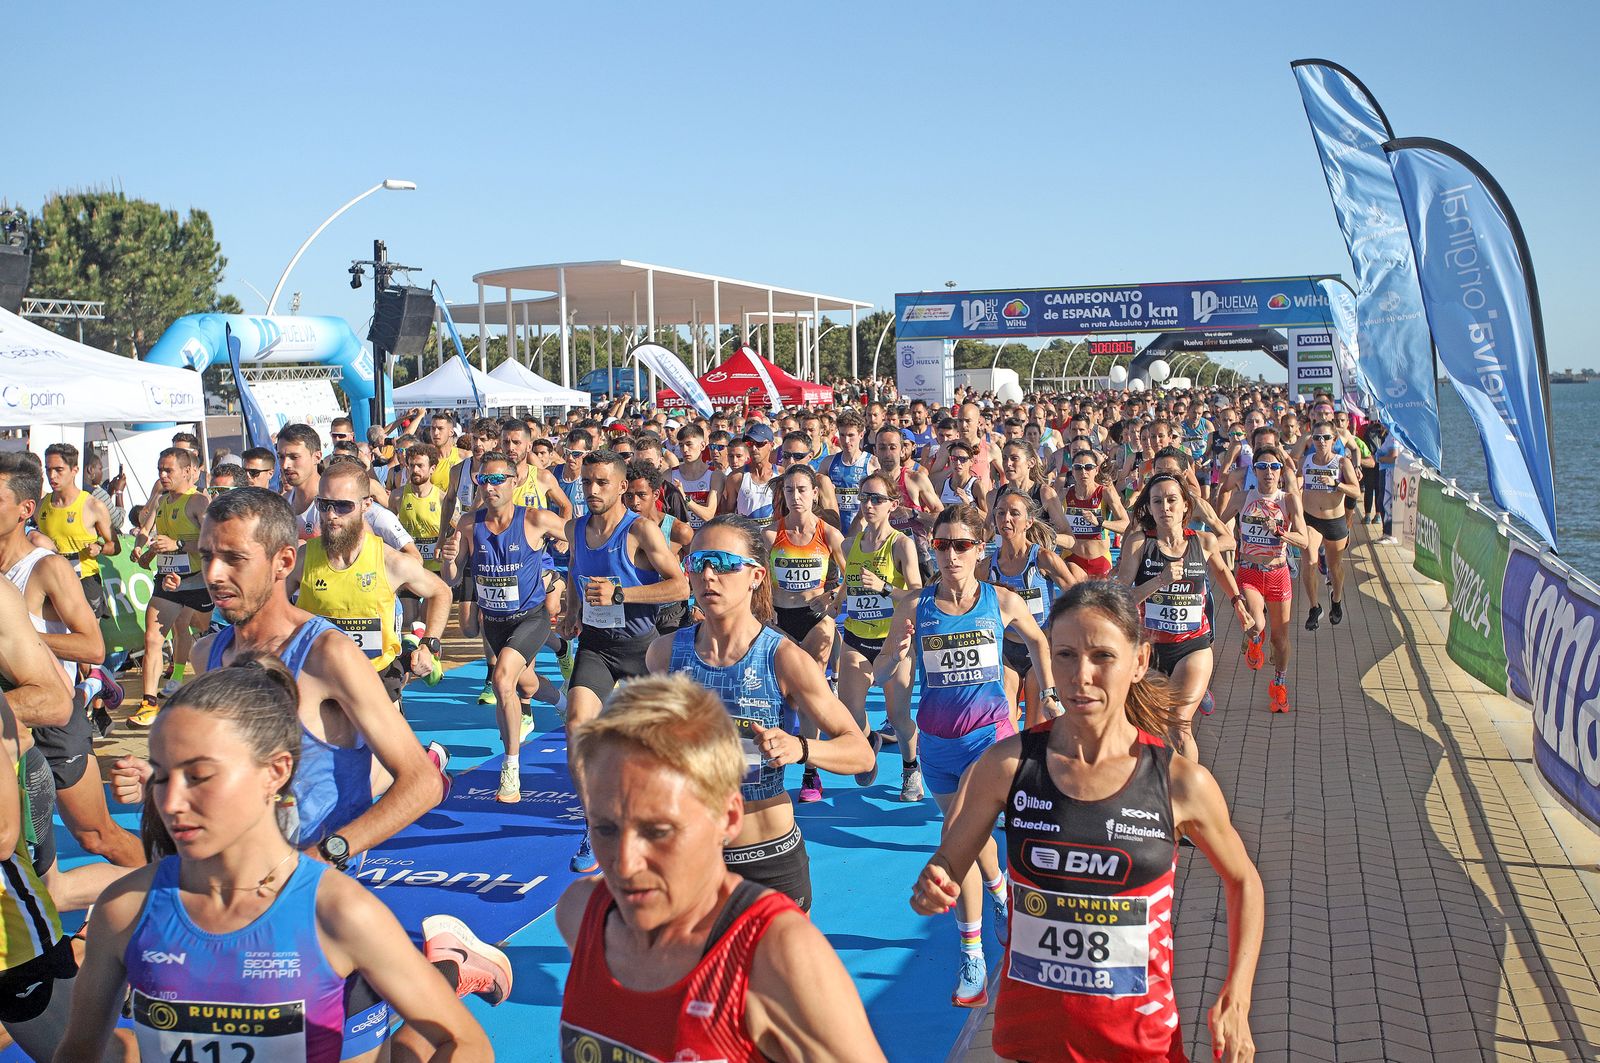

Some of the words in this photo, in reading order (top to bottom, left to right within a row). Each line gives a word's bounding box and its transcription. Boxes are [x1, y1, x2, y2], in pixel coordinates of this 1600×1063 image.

[1044, 290, 1142, 305] CAMPEONATO
[1216, 295, 1258, 309] HUELVA
[1044, 310, 1059, 320] de
[1062, 306, 1112, 319] ESPAÑA
[1120, 304, 1142, 319] 10
[1148, 302, 1178, 318] km
[164, 556, 174, 565] 77
[785, 569, 811, 581] 410
[484, 588, 506, 599] 174
[1171, 584, 1190, 592] BM
[856, 597, 880, 609] 422
[1160, 607, 1188, 621] 489
[940, 649, 980, 670] 499
[1014, 790, 1052, 812] Bilbao
[1115, 823, 1166, 839] Bizkaialde
[724, 849, 765, 862] alance
[1064, 851, 1120, 877] BM
[1057, 897, 1130, 911] RUNNING
[1074, 912, 1119, 924] LOOP
[1038, 926, 1110, 963] 498
[244, 959, 301, 968] SEOANE
[189, 1006, 280, 1020] RUNNING
[212, 1022, 264, 1034] LOOP
[170, 1038, 256, 1063] 412
